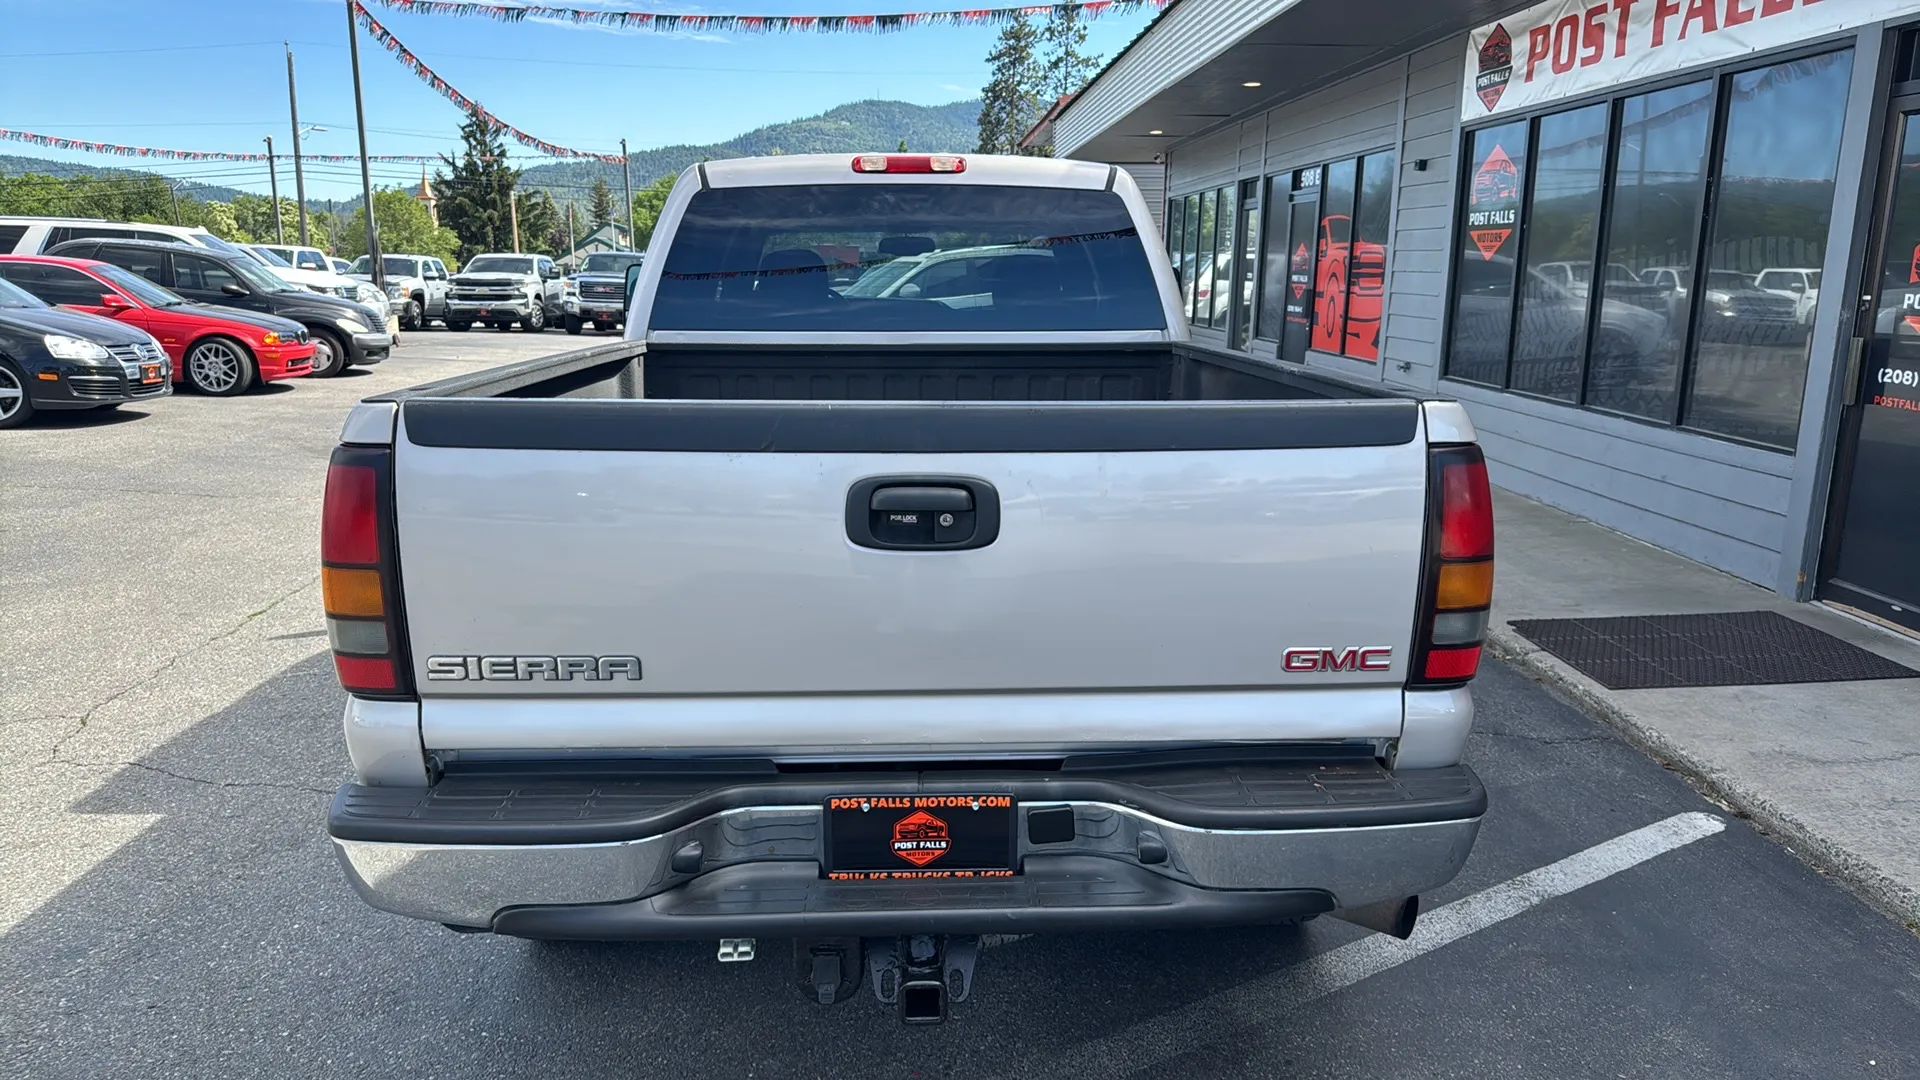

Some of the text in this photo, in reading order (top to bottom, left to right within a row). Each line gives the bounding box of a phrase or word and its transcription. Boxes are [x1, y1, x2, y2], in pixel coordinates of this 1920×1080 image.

[1524, 0, 1826, 83] POST FAL
[1469, 209, 1515, 226] POST FALLS
[1877, 367, 1920, 388] (208)
[426, 655, 643, 681] SIERRA
[1281, 645, 1393, 672] GMC
[831, 795, 1012, 810] POST FALLS MOTORSCOM
[894, 841, 947, 850] POST FALLS
